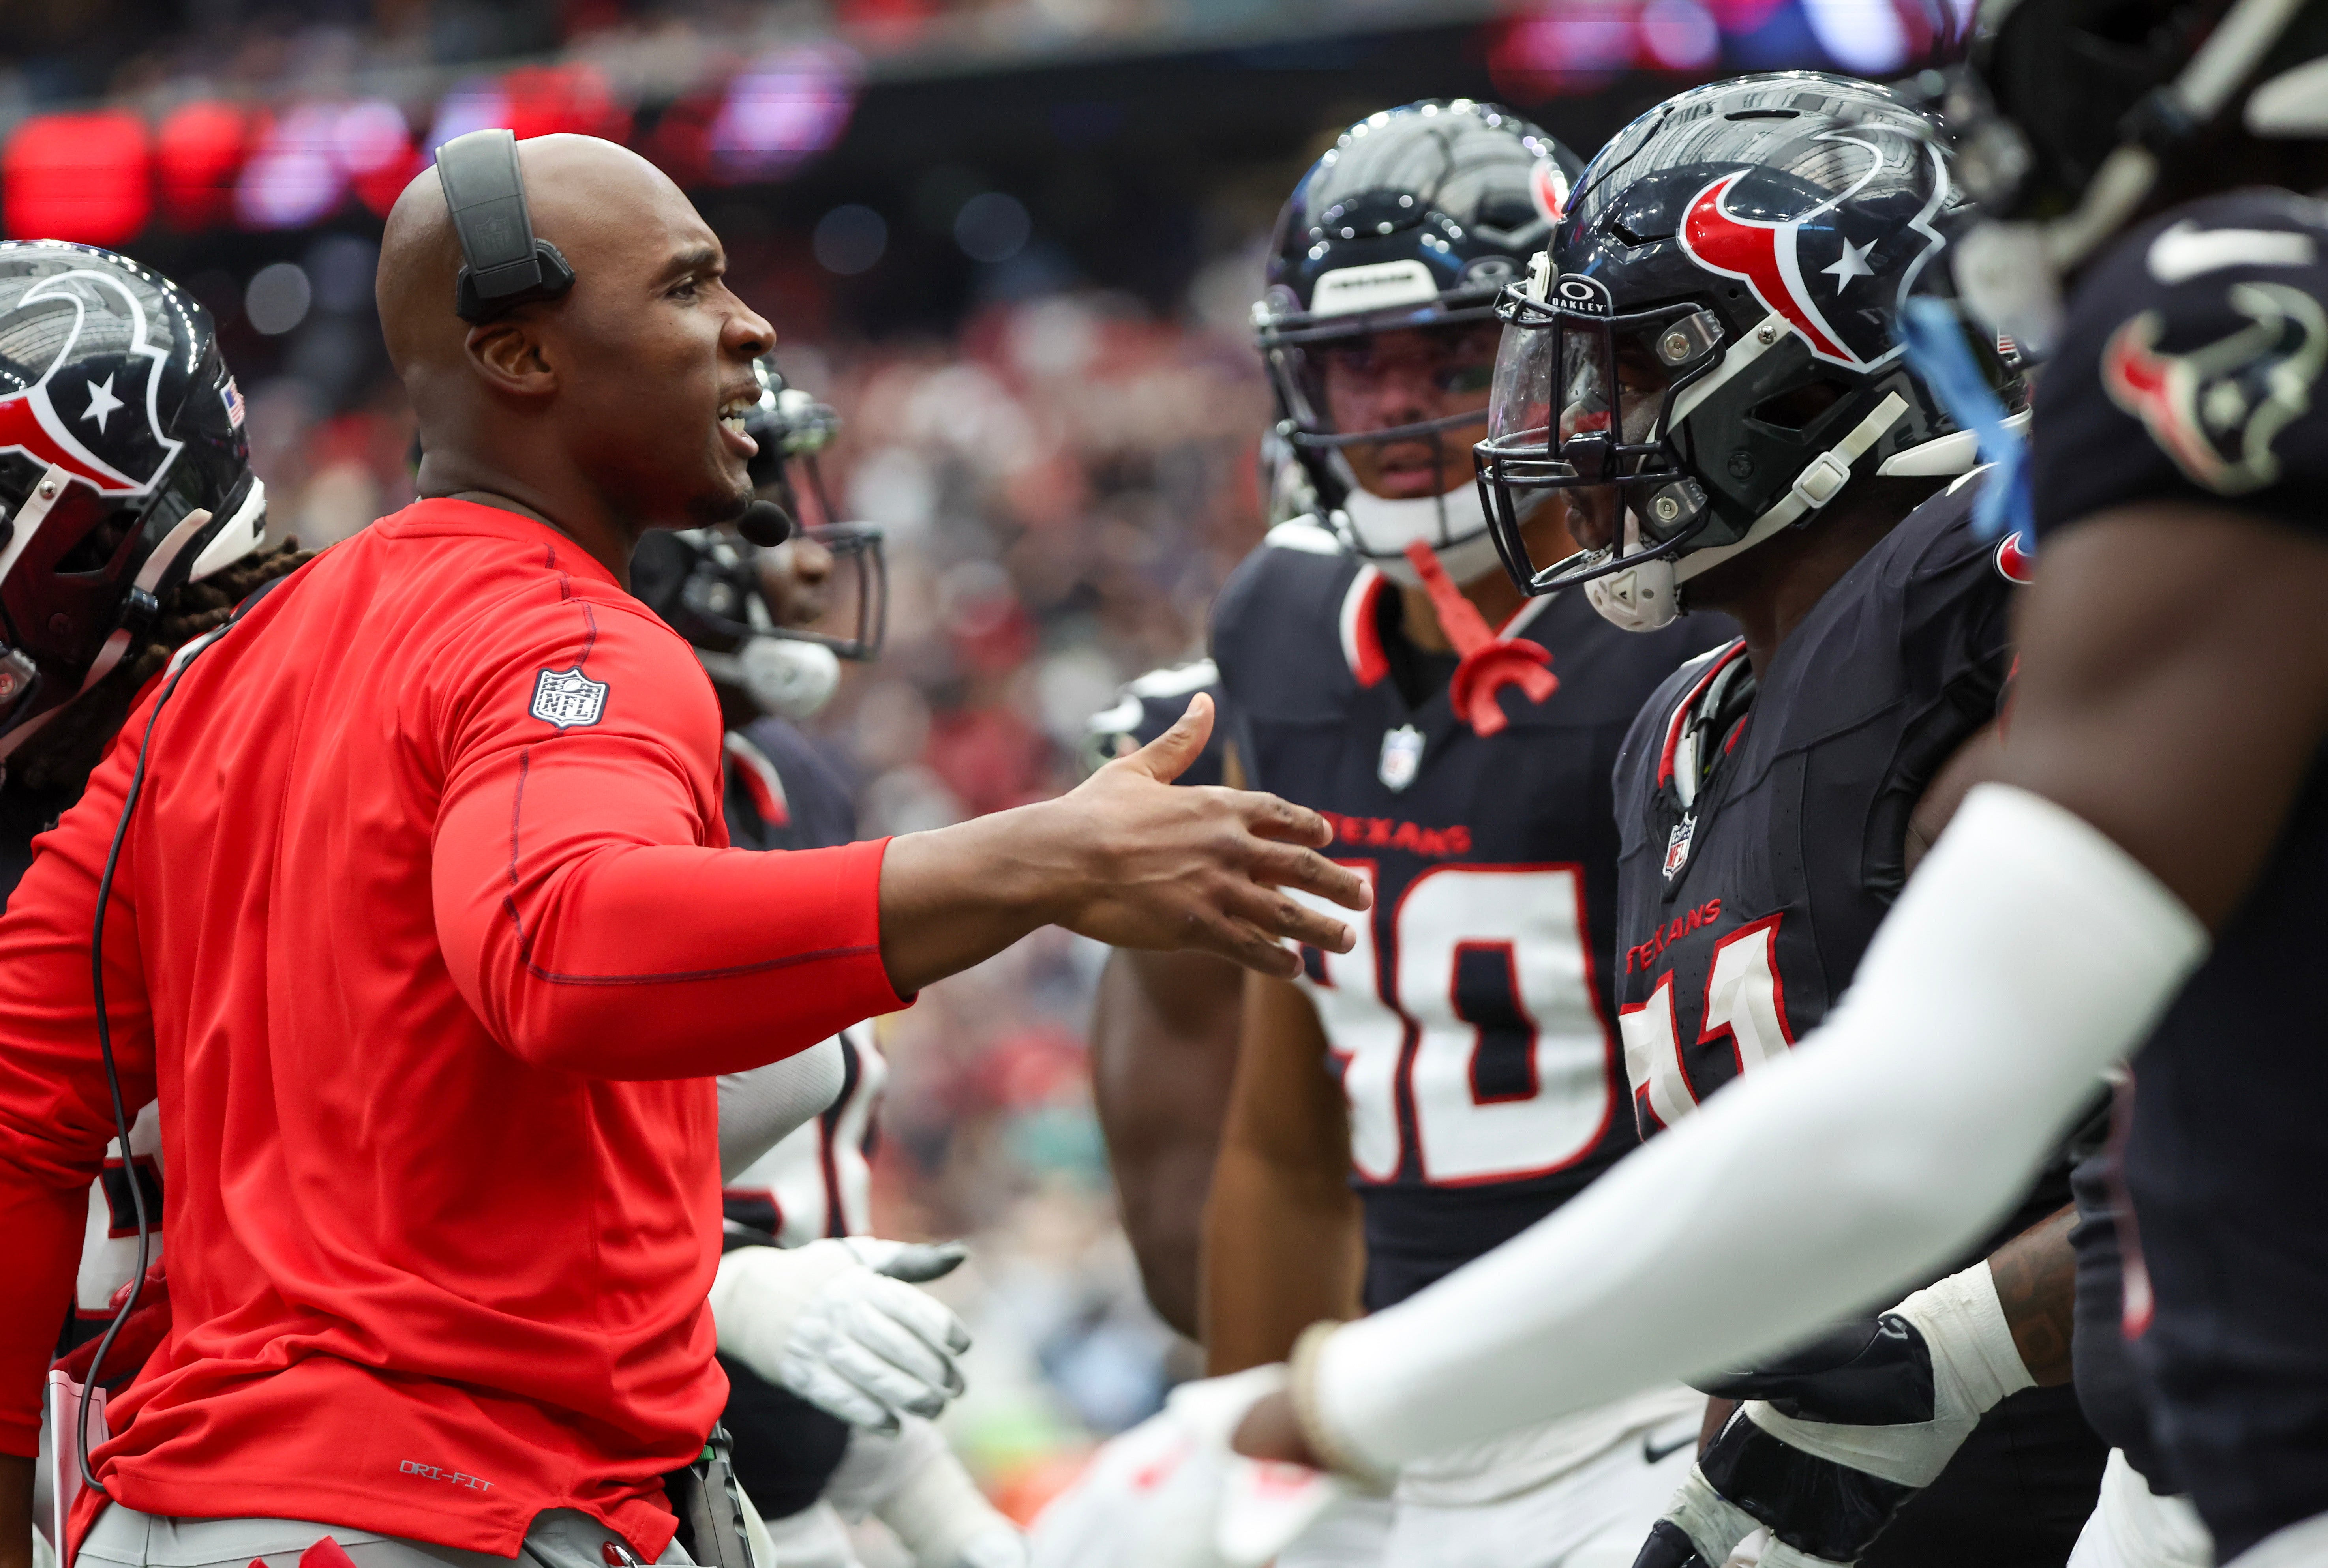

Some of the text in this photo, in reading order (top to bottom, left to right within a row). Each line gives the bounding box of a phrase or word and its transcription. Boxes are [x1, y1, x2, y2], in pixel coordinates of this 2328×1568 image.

[1552, 297, 1604, 313] OAKLEY
[538, 690, 595, 719] NFL
[1666, 843, 1685, 868] NFL
[1625, 898, 1722, 974] TEXANS
[399, 1459, 495, 1491] DRI-FIT
